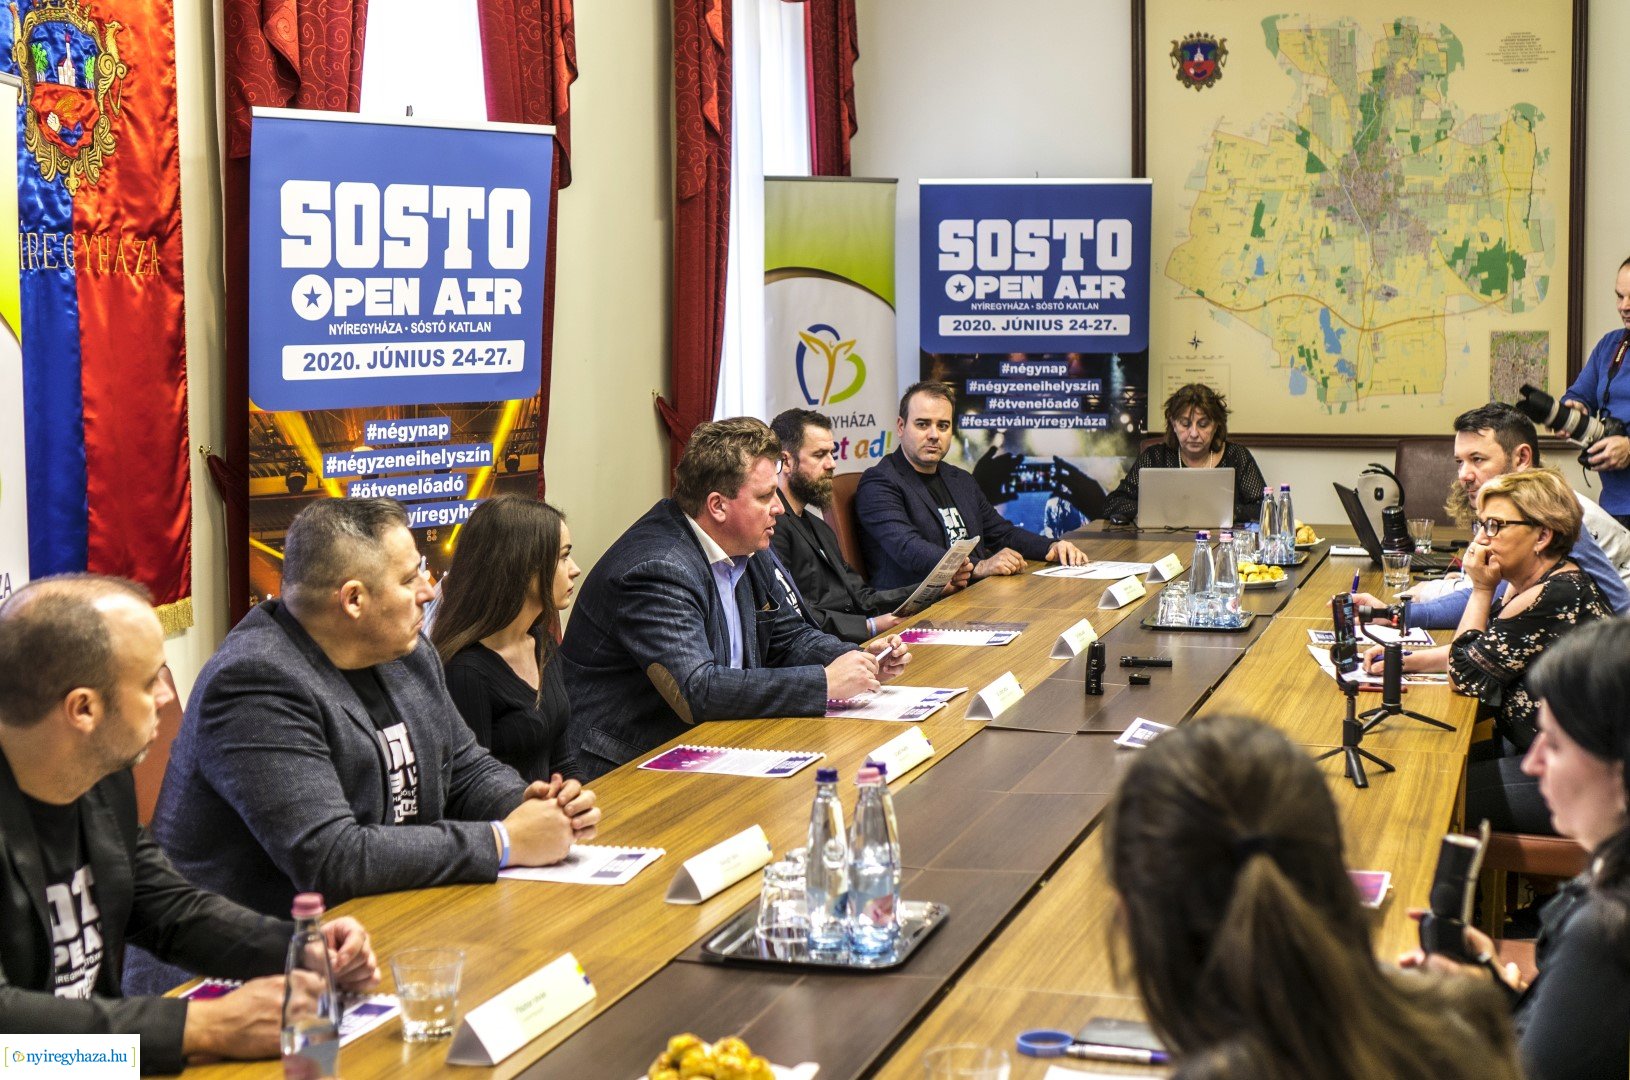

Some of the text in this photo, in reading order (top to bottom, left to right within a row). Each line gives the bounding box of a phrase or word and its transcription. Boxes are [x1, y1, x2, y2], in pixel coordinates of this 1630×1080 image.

[280, 179, 531, 270] SOSTO
[938, 218, 1133, 271] SOSTO
[291, 274, 523, 321] OPEN AIR
[945, 273, 1126, 302] OPEN AIR
[971, 302, 1099, 311] NYÍREGYHÁZA SÓSTÓ KATLAN
[328, 319, 492, 336] NYÍREGYHÁZA SÓSTÓ KATLAN
[952, 317, 1117, 332] 2020. JÚNIUS 24-27.
[302, 346, 512, 372] 2020. JÚNIUS 24-27.
[1001, 363, 1067, 376] #négynap
[969, 380, 1100, 394] #négyzeneihelyszín
[988, 398, 1080, 409] #ötvenelőadó
[961, 415, 1107, 428] #fesztiválnyíregyháza
[366, 422, 449, 442] #négynap
[326, 447, 491, 474] #négyzeneihelyszín
[351, 475, 465, 499] #ötvenelőadó
